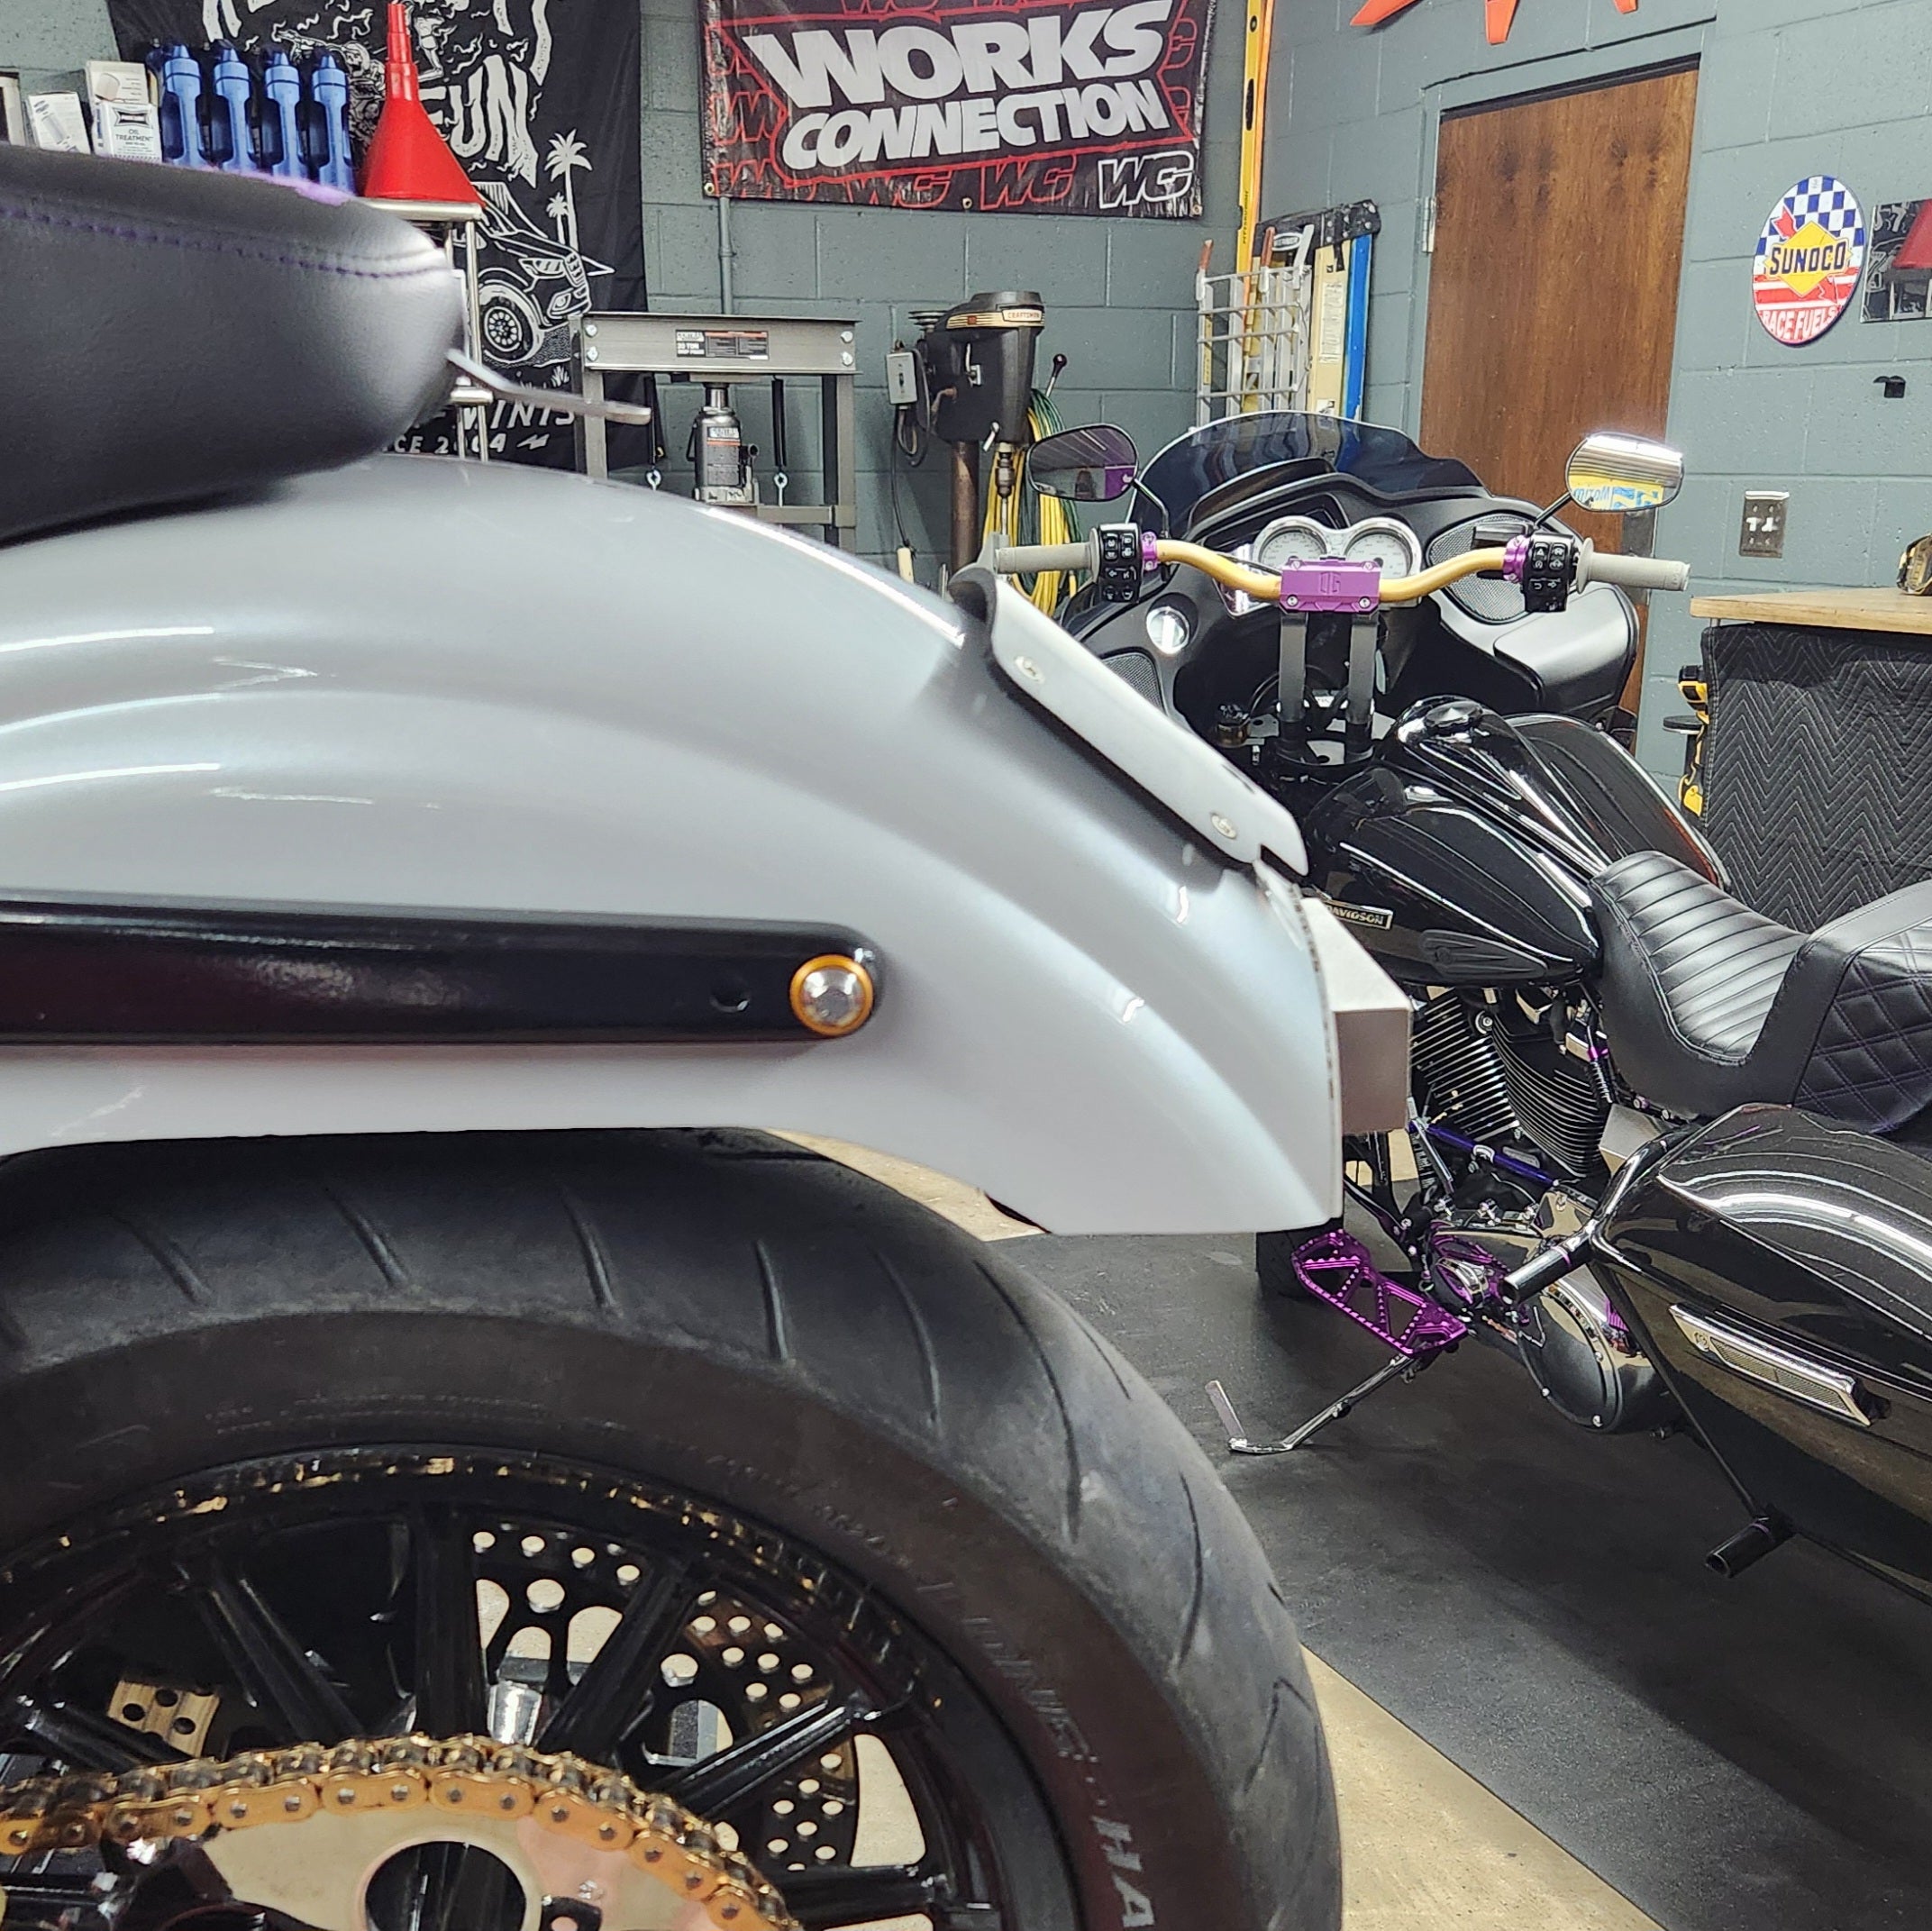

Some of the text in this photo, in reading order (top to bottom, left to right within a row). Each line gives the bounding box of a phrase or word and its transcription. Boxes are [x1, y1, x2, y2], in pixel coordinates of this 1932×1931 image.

[743, 0, 1171, 108] WORKS
[781, 79, 1171, 170] CONNECTION
[1769, 241, 1847, 275] SUNOCO
[1763, 306, 1836, 341] RACE FUELS
